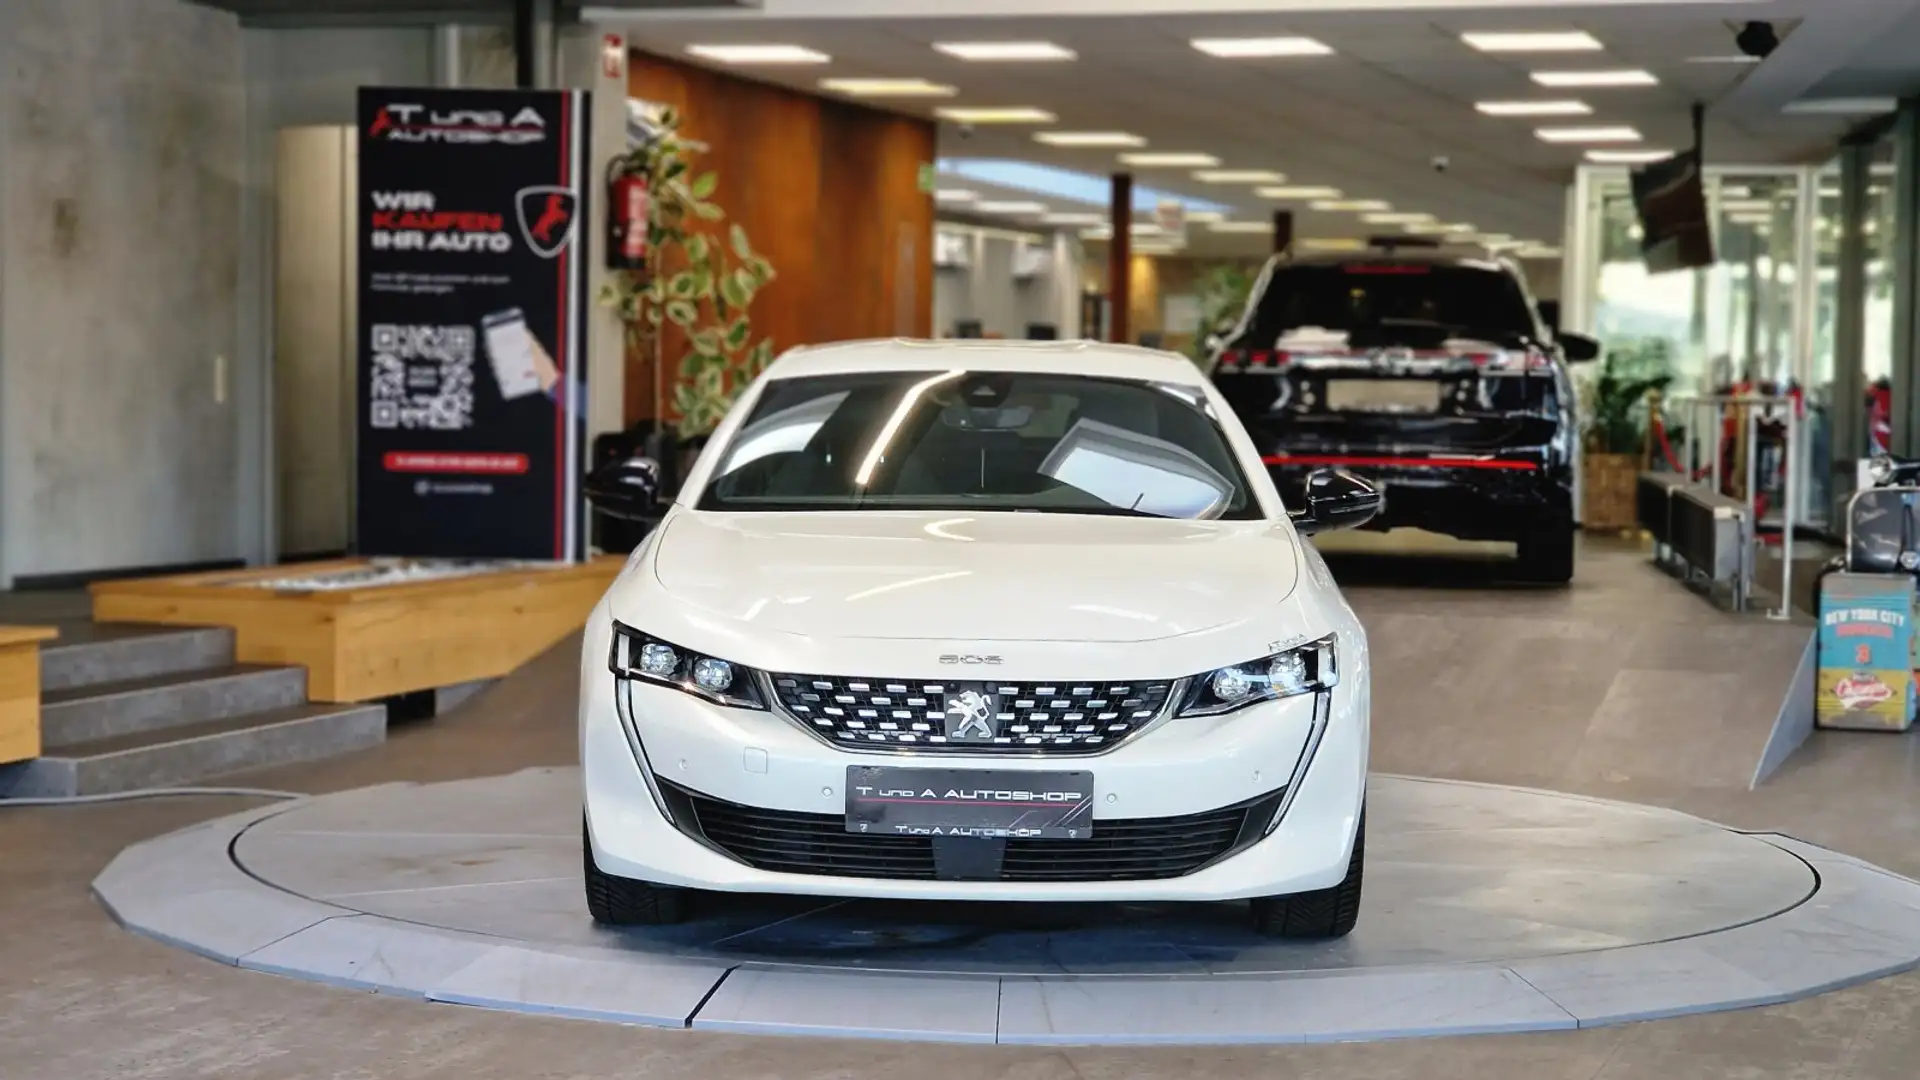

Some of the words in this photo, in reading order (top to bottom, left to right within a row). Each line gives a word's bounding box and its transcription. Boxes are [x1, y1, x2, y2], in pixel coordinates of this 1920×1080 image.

[387, 104, 424, 124] T
[510, 106, 546, 127] A
[371, 191, 435, 210] WIR
[371, 211, 504, 232] KAUFEN
[371, 230, 425, 250] IHR
[427, 231, 513, 253] AUTO
[855, 786, 873, 797] T
[920, 788, 938, 798] A
[943, 789, 1082, 802] AUTOSHOP
[949, 826, 1043, 837] AUTOSHOP
